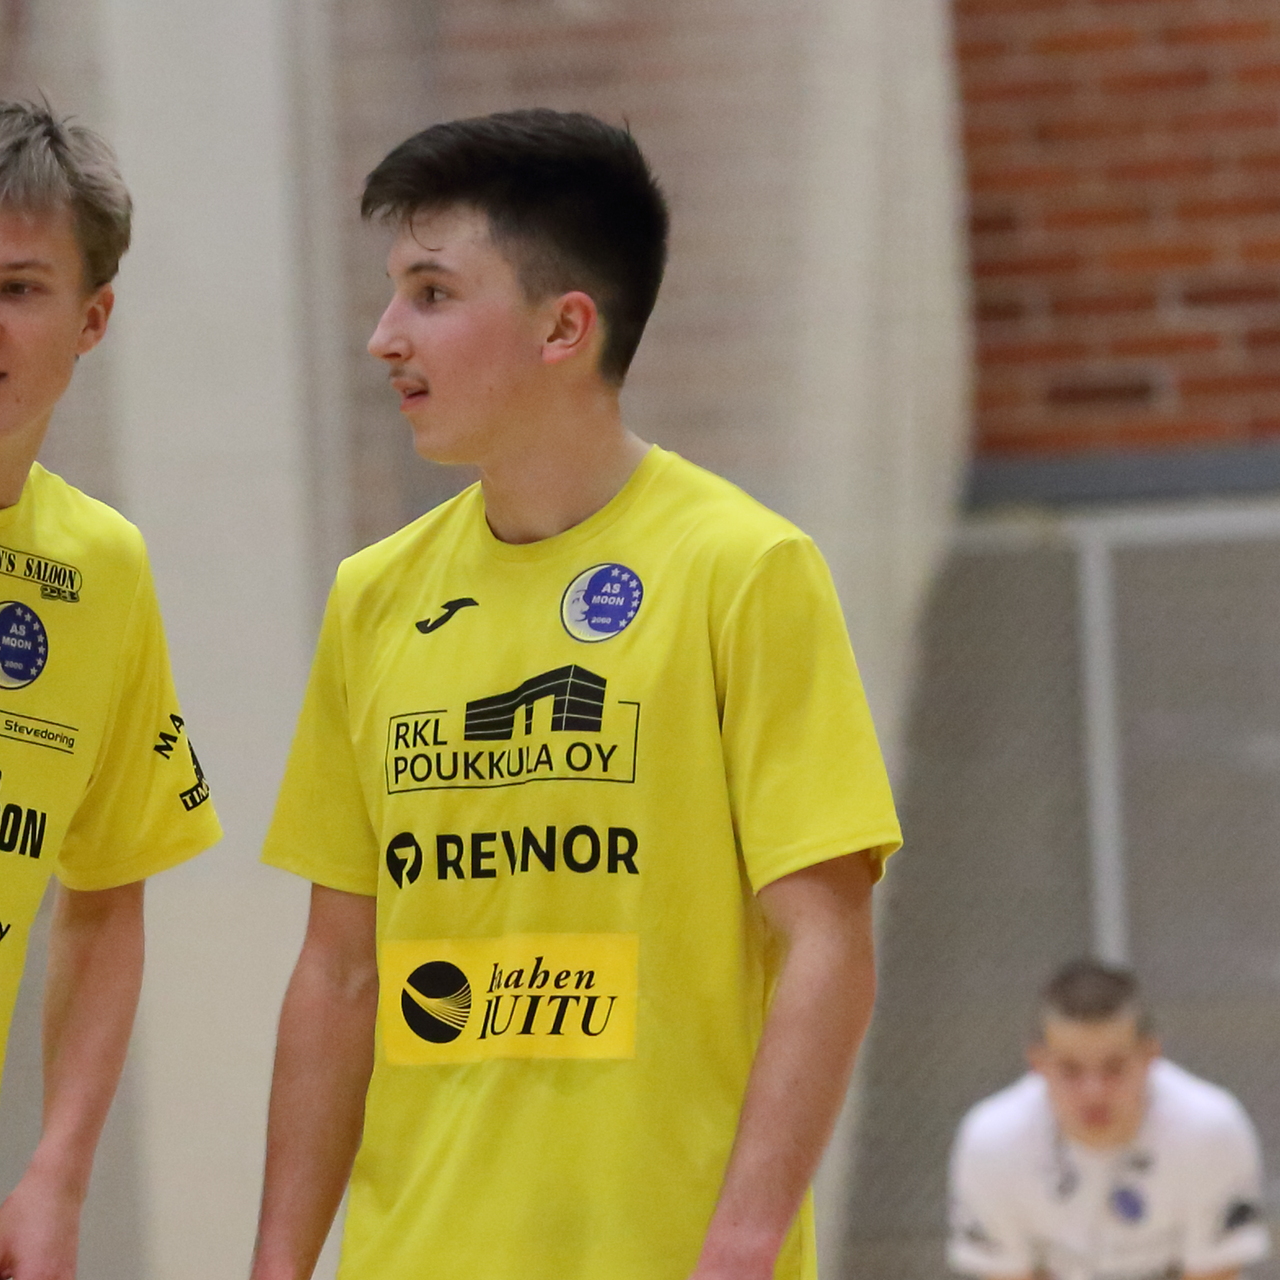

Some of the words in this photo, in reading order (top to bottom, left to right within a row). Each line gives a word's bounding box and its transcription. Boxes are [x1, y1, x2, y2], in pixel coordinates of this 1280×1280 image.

[24, 558, 77, 590] SALOON
[601, 582, 621, 594] AS
[592, 595, 625, 606] MOON
[10, 623, 26, 636] AS
[2, 636, 32, 650] MOON
[4, 719, 75, 748] Stevedoring
[394, 718, 448, 750] RKL
[394, 742, 554, 785] POUKKULA
[565, 741, 618, 772] OY
